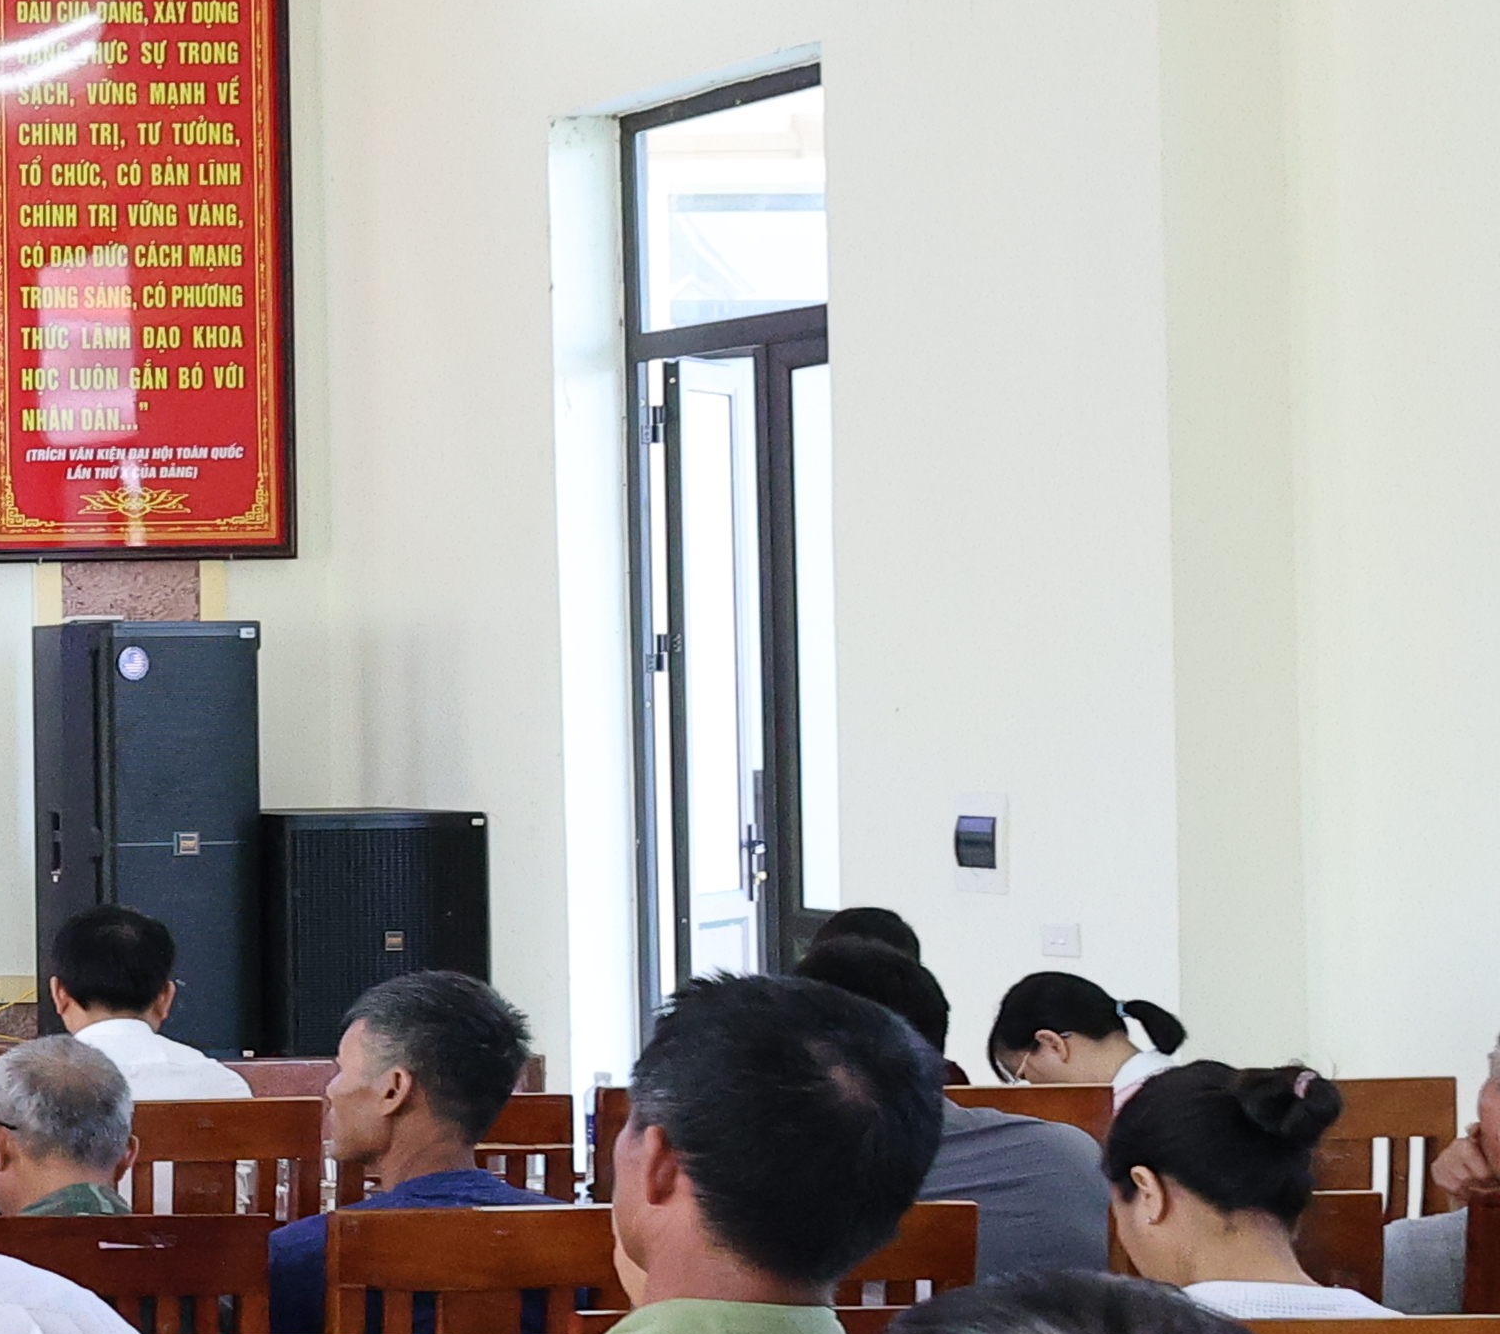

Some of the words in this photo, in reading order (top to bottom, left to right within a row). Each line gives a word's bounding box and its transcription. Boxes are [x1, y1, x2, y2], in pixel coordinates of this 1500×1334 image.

[191, 0, 239, 28] DỰNG
[140, 40, 166, 69] SỰ
[178, 42, 239, 64] TRONG
[86, 78, 138, 105] VỮNG
[149, 82, 206, 109] MẠNH
[88, 123, 126, 150] TRỊ,
[136, 121, 162, 145] TƯ
[171, 115, 241, 147] TƯỞNG,
[18, 155, 42, 186] TỔ
[51, 159, 108, 189] CHỨC,
[116, 159, 142, 186] CÓ
[150, 156, 190, 185] BẢN
[198, 159, 241, 185] LĨNH
[19, 200, 78, 227] CHÍNH
[87, 205, 117, 231] TRỊ
[127, 200, 178, 226] VỮNG
[187, 199, 244, 228] VÀNG,
[19, 241, 45, 269] CÓ
[134, 240, 183, 267] CÁCH
[188, 244, 243, 271] MẠNG
[19, 285, 78, 309] TRONG
[142, 281, 167, 308] CÓ
[171, 283, 244, 307] PHƯƠNG
[142, 326, 181, 353] ĐẠO
[192, 326, 244, 348] KHOA
[21, 366, 59, 396] HỌC
[69, 363, 119, 390] LUÔN
[128, 359, 168, 390] GẮN
[178, 362, 204, 389] BÓ
[213, 362, 245, 388] VỚI
[21, 404, 74, 432] NHÂN
